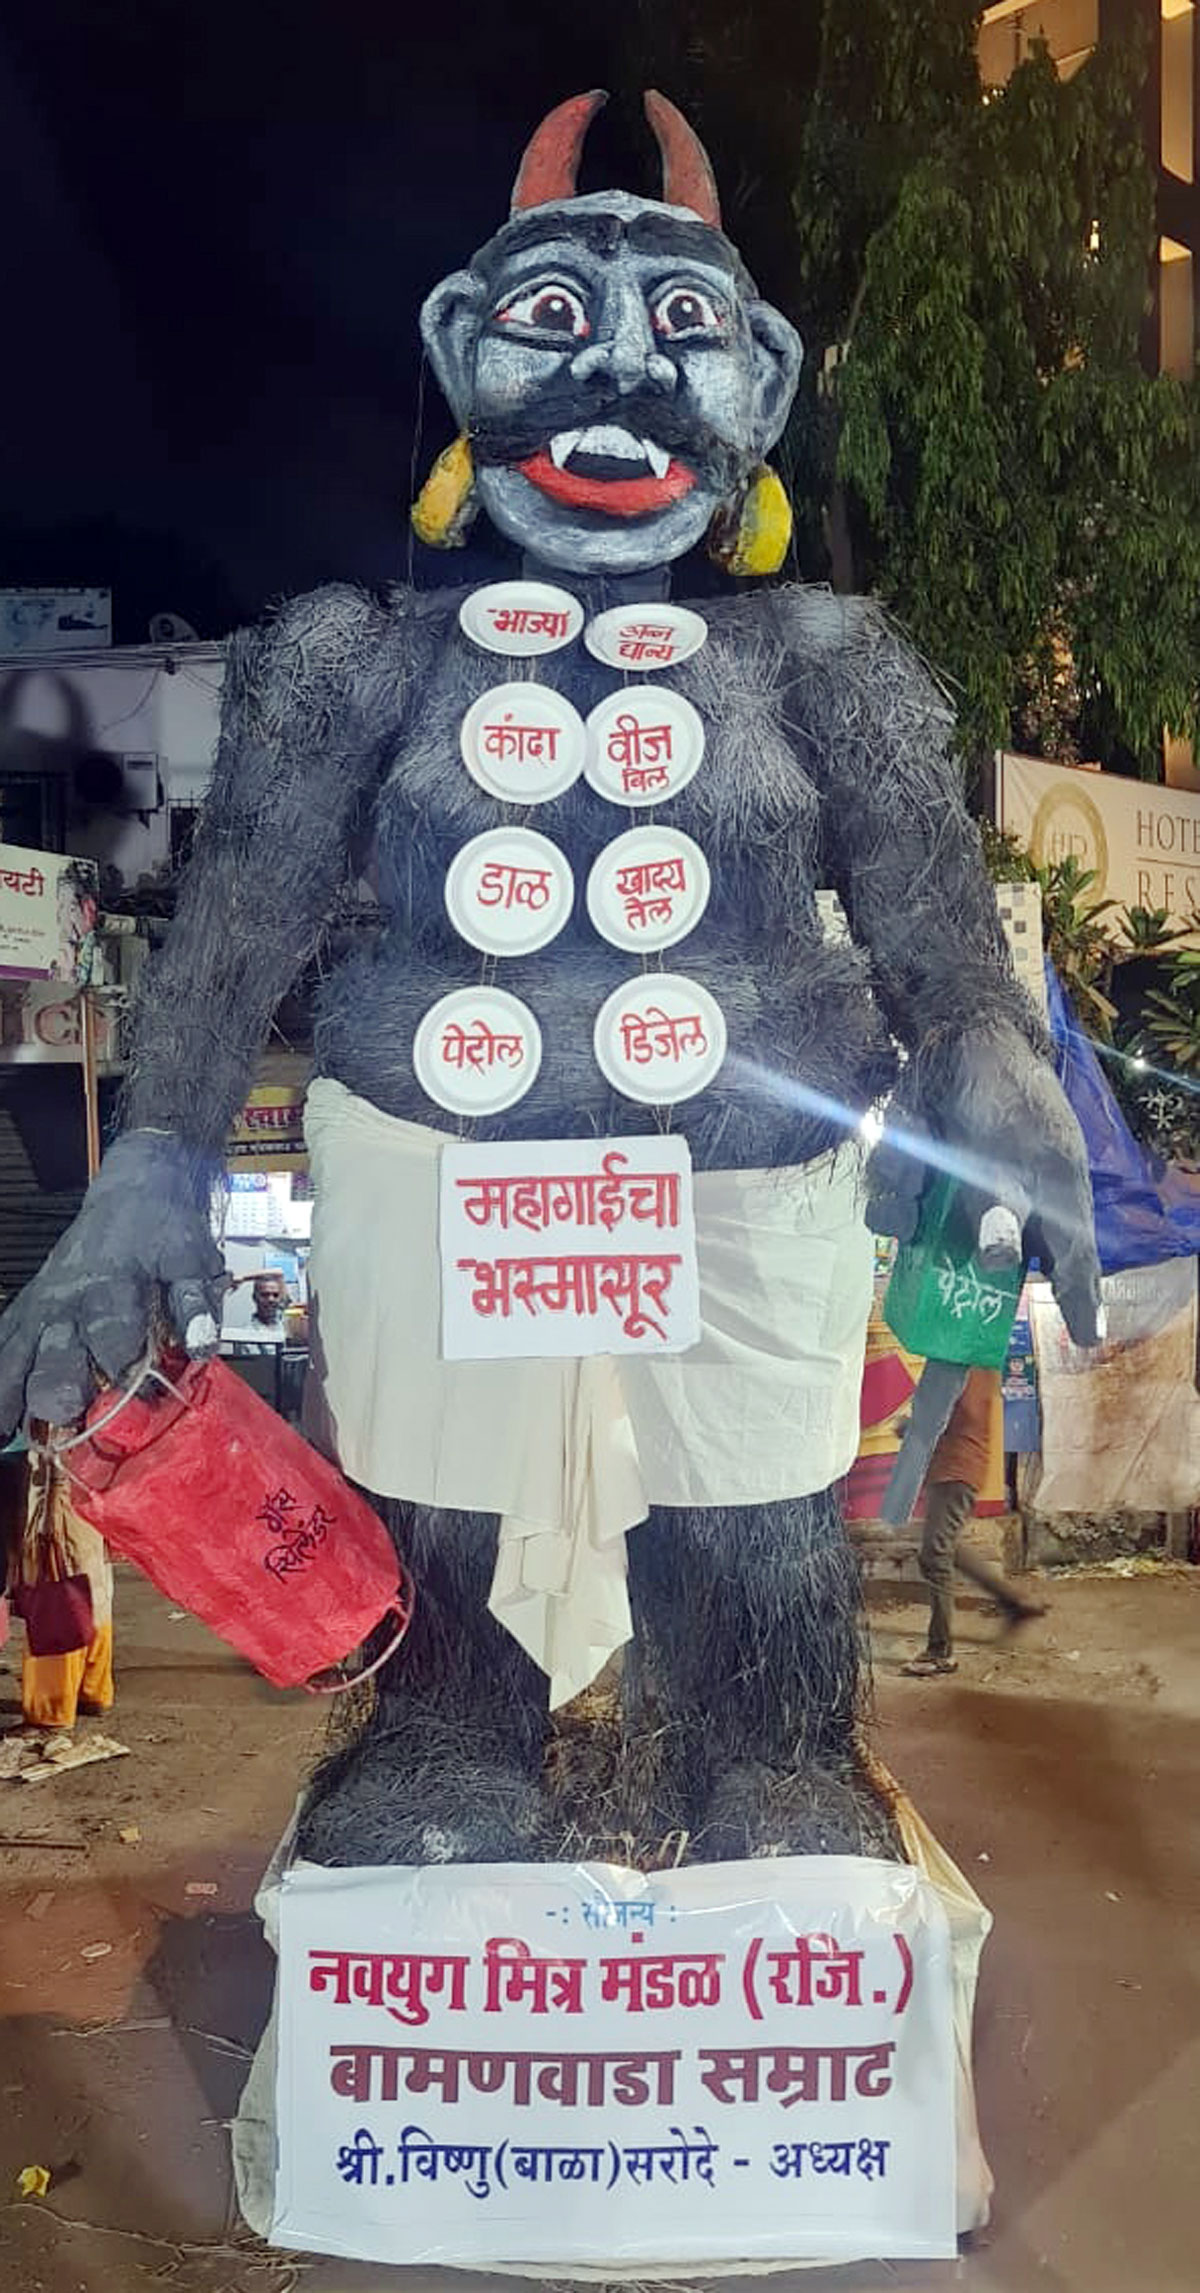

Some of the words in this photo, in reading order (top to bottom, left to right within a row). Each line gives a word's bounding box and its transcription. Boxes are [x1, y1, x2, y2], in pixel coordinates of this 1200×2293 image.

[483, 713, 561, 762] कांदा
[607, 714, 672, 766] वीज
[0, 867, 45, 897] यटी
[477, 863, 553, 910] डाळ
[616, 858, 686, 895] खाद्य
[624, 896, 672, 930] तेल
[443, 1020, 524, 1075] पेट्रोल
[620, 1007, 708, 1064] डिजेल
[455, 1151, 681, 1233] महागाईचा
[456, 1254, 683, 1341] भस्मासूर
[308, 1949, 470, 2026] नवयुग
[483, 1937, 587, 2013] मित्र
[600, 1931, 725, 2012] मंडळ
[330, 2045, 682, 2107] बामणवाडा
[697, 2041, 896, 2109] सम्राट
[769, 2137, 890, 2181] अध्यक्ष
